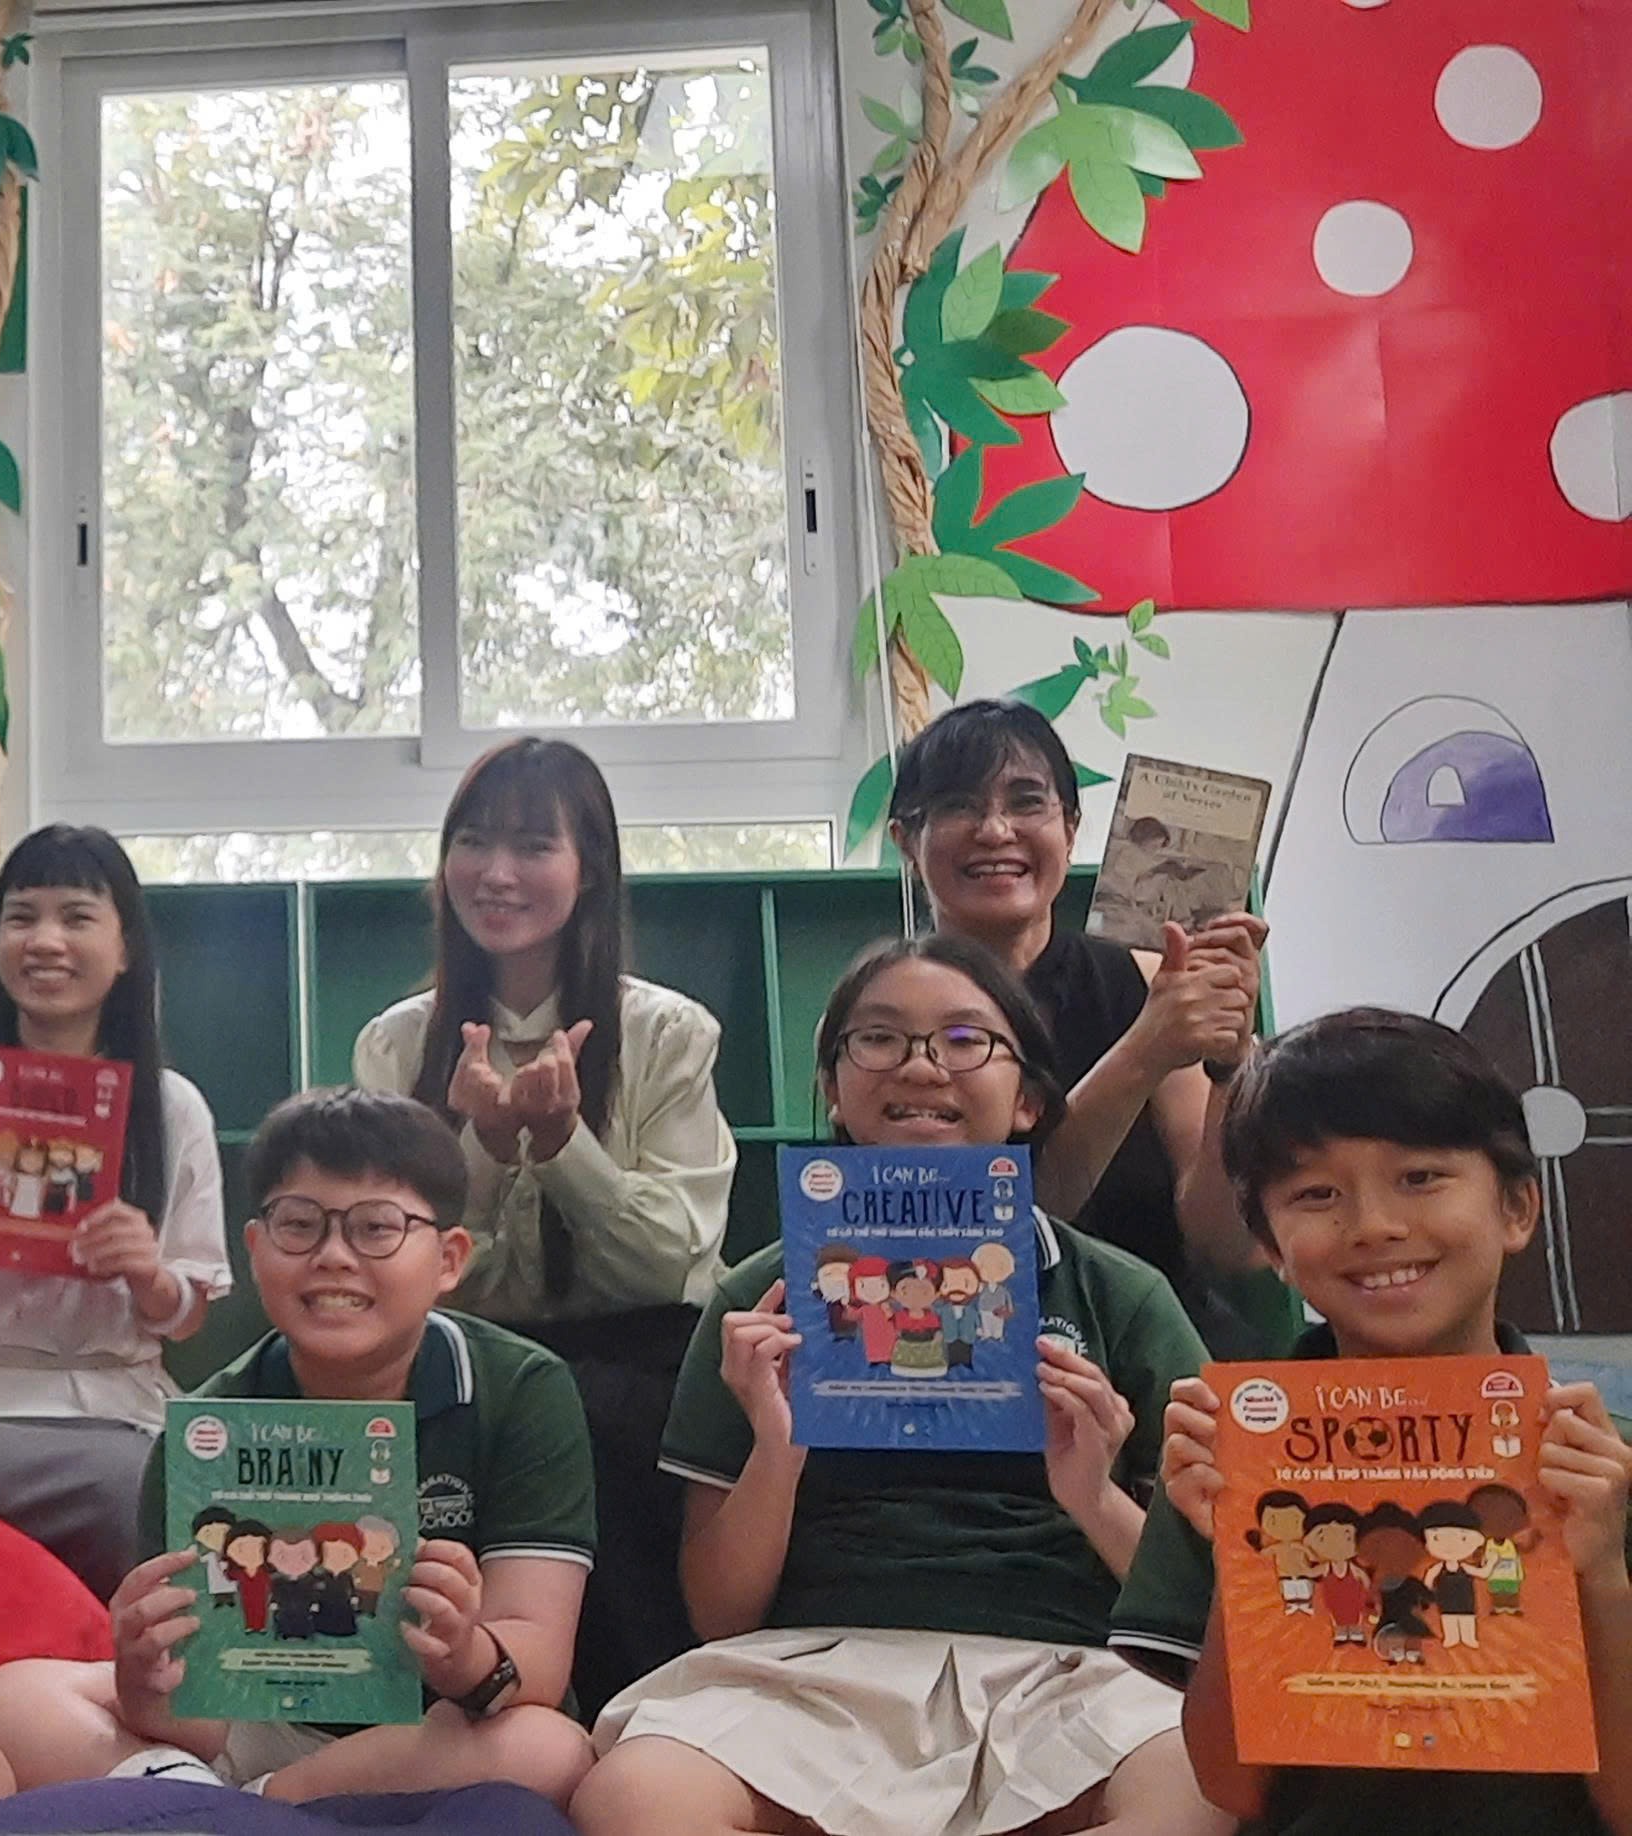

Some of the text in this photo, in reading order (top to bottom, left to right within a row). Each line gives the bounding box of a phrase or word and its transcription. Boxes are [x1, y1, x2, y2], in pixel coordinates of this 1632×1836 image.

[842, 1187, 985, 1226] CREATIVE
[1330, 1386, 1372, 1409] CAN
[1285, 1413, 1473, 1463] SPORTY
[237, 1447, 345, 1487] BRANY
